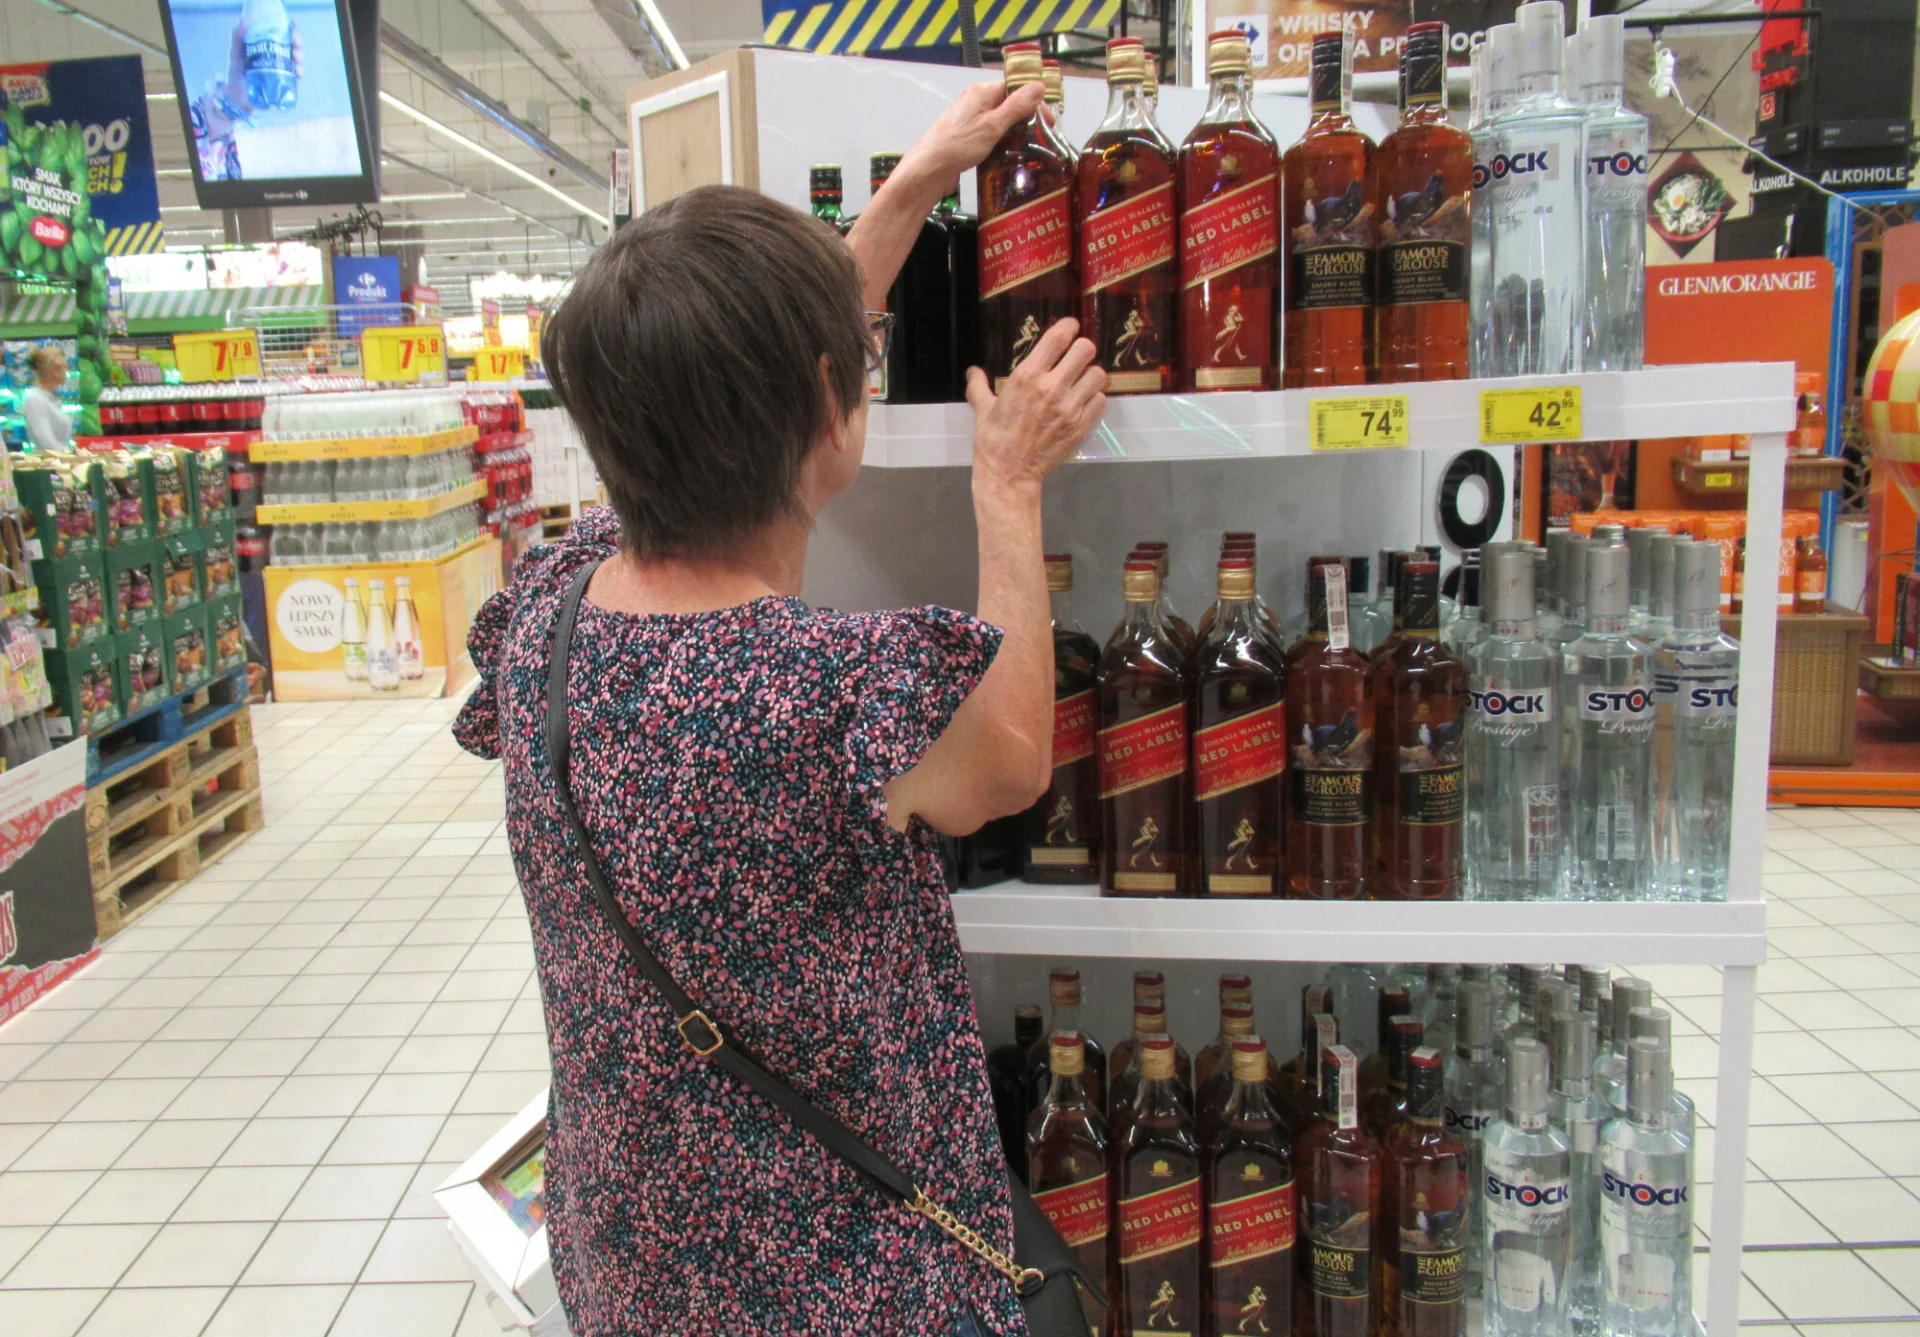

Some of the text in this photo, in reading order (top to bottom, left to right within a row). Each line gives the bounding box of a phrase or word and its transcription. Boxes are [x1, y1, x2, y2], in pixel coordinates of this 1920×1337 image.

[1279, 10, 1374, 35] WHISKY
[35, 167, 62, 188] SMAK
[1821, 167, 1906, 184] ALKOHOLE
[12, 176, 82, 205] KTÓRY WSZYSCY
[26, 195, 71, 217] KOCHAMY
[35, 221, 65, 241] Barilla
[984, 218, 1066, 260] RED LABEL
[1087, 212, 1170, 254] RED LABEL
[1186, 205, 1271, 249] RED LABEL
[1313, 251, 1366, 265] FAMOUS
[1394, 246, 1449, 261] FAMOUS
[1394, 257, 1449, 272] GROUSE
[1313, 261, 1366, 276] GROUSE
[348, 285, 388, 297] Produkt
[1658, 270, 1817, 297] GLENMORANGIE
[212, 341, 227, 372] 7
[399, 339, 414, 369] 7
[1360, 410, 1393, 437] 74
[1392, 408, 1404, 418] 99
[1528, 401, 1562, 427] 42
[1561, 398, 1574, 408] 99
[290, 594, 333, 605] NOWY
[289, 610, 334, 622] LEPSZY
[294, 625, 334, 637] SMAK
[1467, 691, 1545, 715] TOCK
[1104, 729, 1183, 763] RED LABEL
[1199, 729, 1281, 764] RED LABEL
[1311, 774, 1363, 786] FAMOUS
[1311, 784, 1362, 795] GROUSE
[1487, 1176, 1569, 1207] STOCK
[1603, 1172, 1688, 1206] STOCK
[1062, 1198, 1106, 1217] LABEL
[1123, 1201, 1199, 1231] RED LABEL
[1214, 1207, 1292, 1235] RED LABEL
